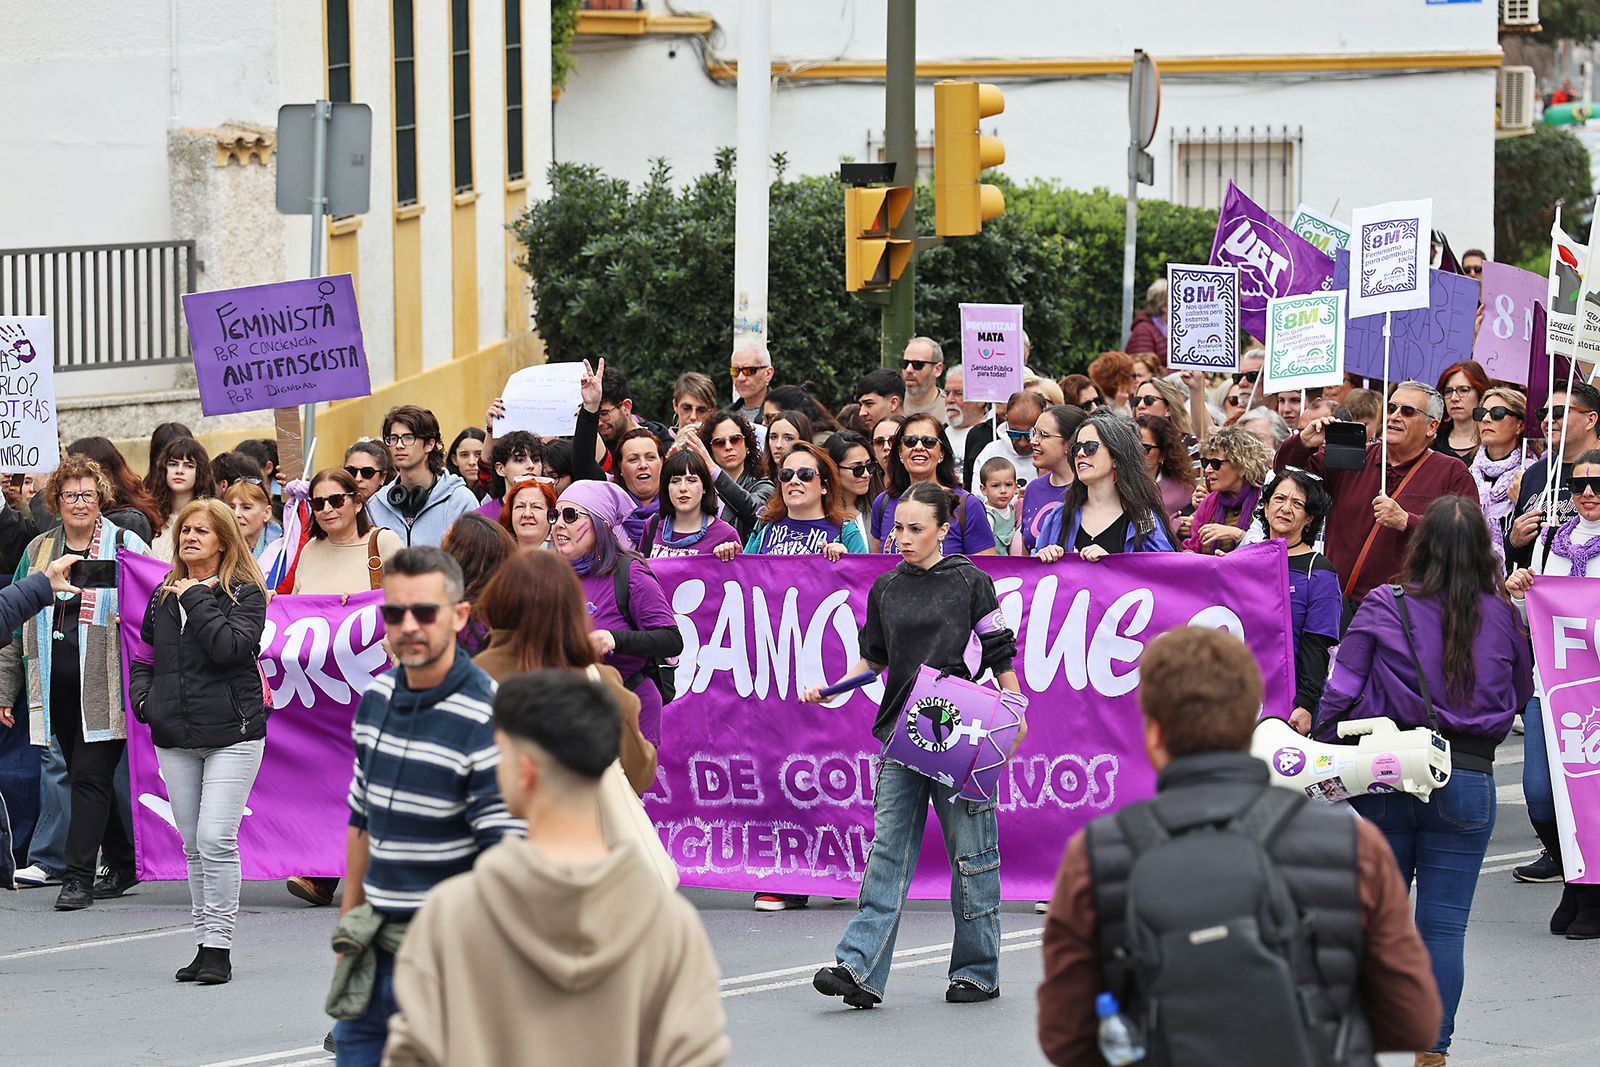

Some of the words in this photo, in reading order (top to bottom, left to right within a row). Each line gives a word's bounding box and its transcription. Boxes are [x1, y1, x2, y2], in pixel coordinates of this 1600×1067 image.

[1372, 230, 1400, 249] 8M
[1365, 245, 1402, 260] Feminismo
[1183, 286, 1216, 304] 8M
[1198, 303, 1219, 311] quieren
[965, 321, 1017, 331] PRIVATIZAR
[1283, 307, 1319, 330] 8M
[977, 332, 1005, 343] MATA
[690, 752, 763, 806] DE
